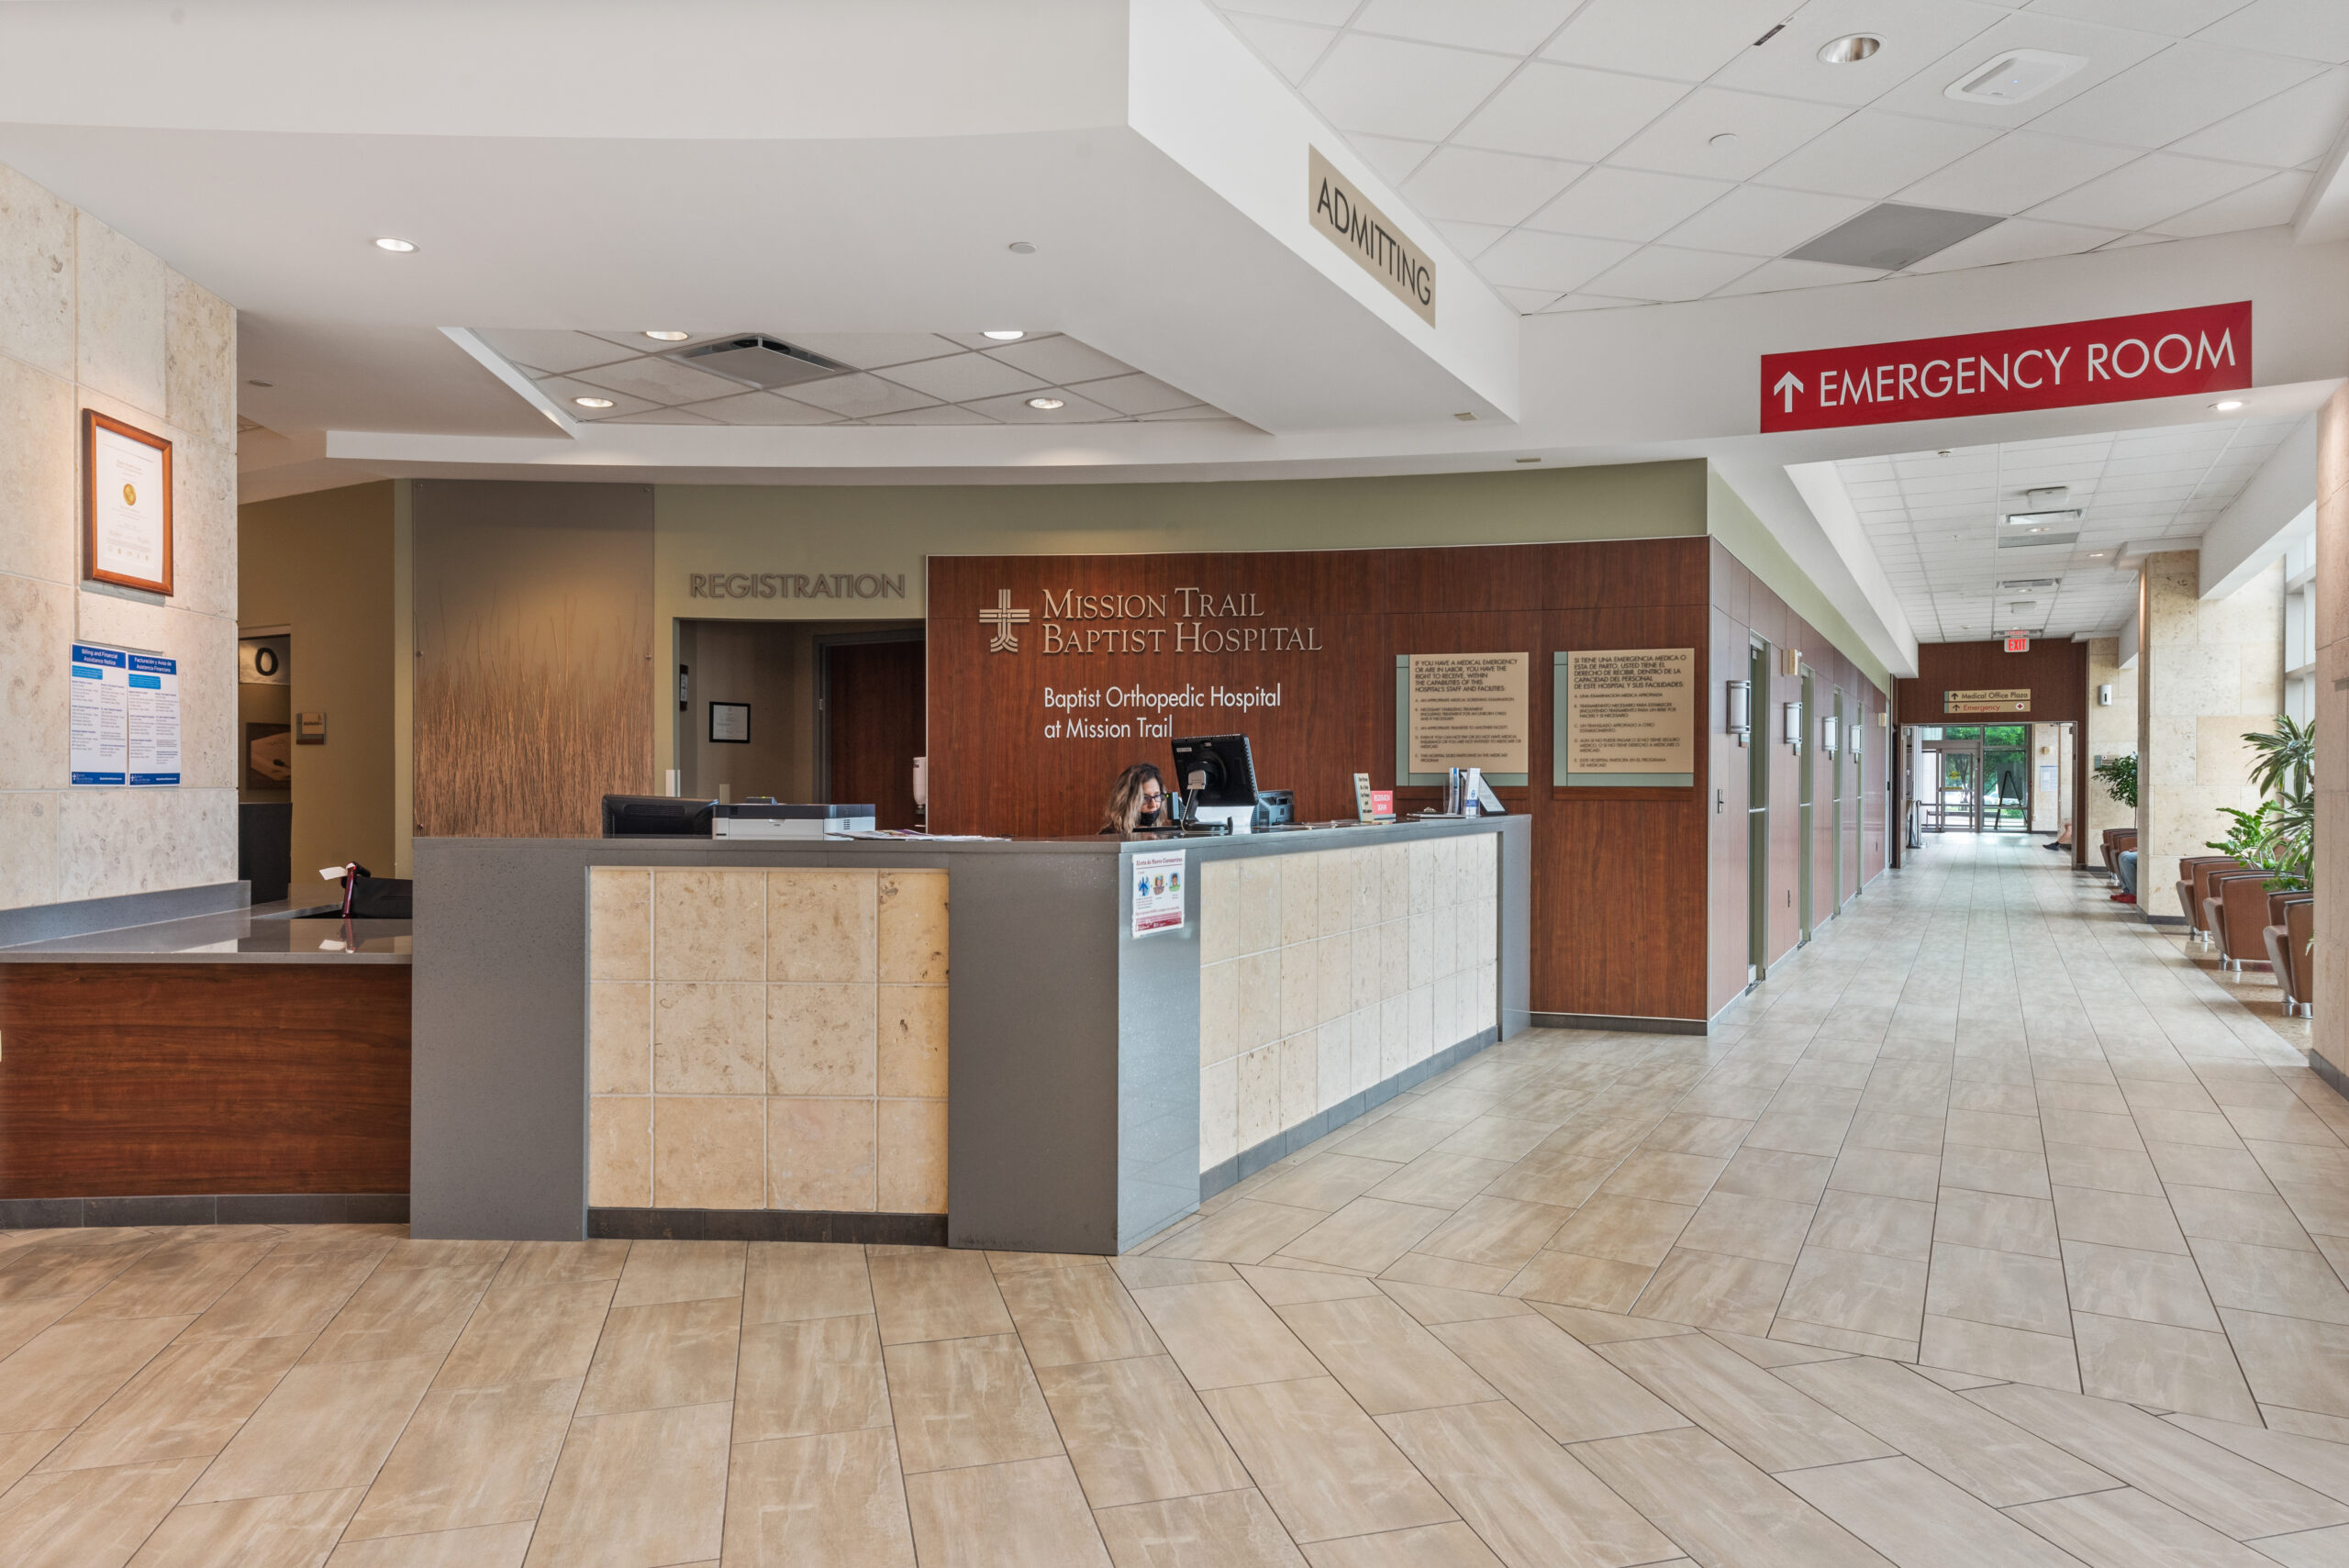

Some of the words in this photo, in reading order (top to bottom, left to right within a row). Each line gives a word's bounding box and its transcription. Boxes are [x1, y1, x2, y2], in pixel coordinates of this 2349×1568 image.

[1317, 176, 1431, 306] ADMITTING
[1820, 346, 2070, 406] EMERGENCY
[2087, 327, 2236, 381] ROOM
[690, 573, 906, 598] REGISTRATION
[1042, 588, 1166, 619] MISSION
[1174, 587, 1264, 617] TRAIL
[81, 648, 94, 656] Billing
[1042, 624, 1166, 654] BAPTIST
[1174, 622, 1323, 653] HOSPITAL
[2008, 639, 2026, 651] EXIT
[83, 656, 104, 664] Assistance
[1043, 687, 1101, 714] Baptist
[1106, 684, 1205, 714] Orthopedic
[1210, 683, 1281, 714] Hospital
[1044, 720, 1062, 739] at
[1066, 717, 1130, 739] Mission
[1136, 715, 1173, 739] Trail
